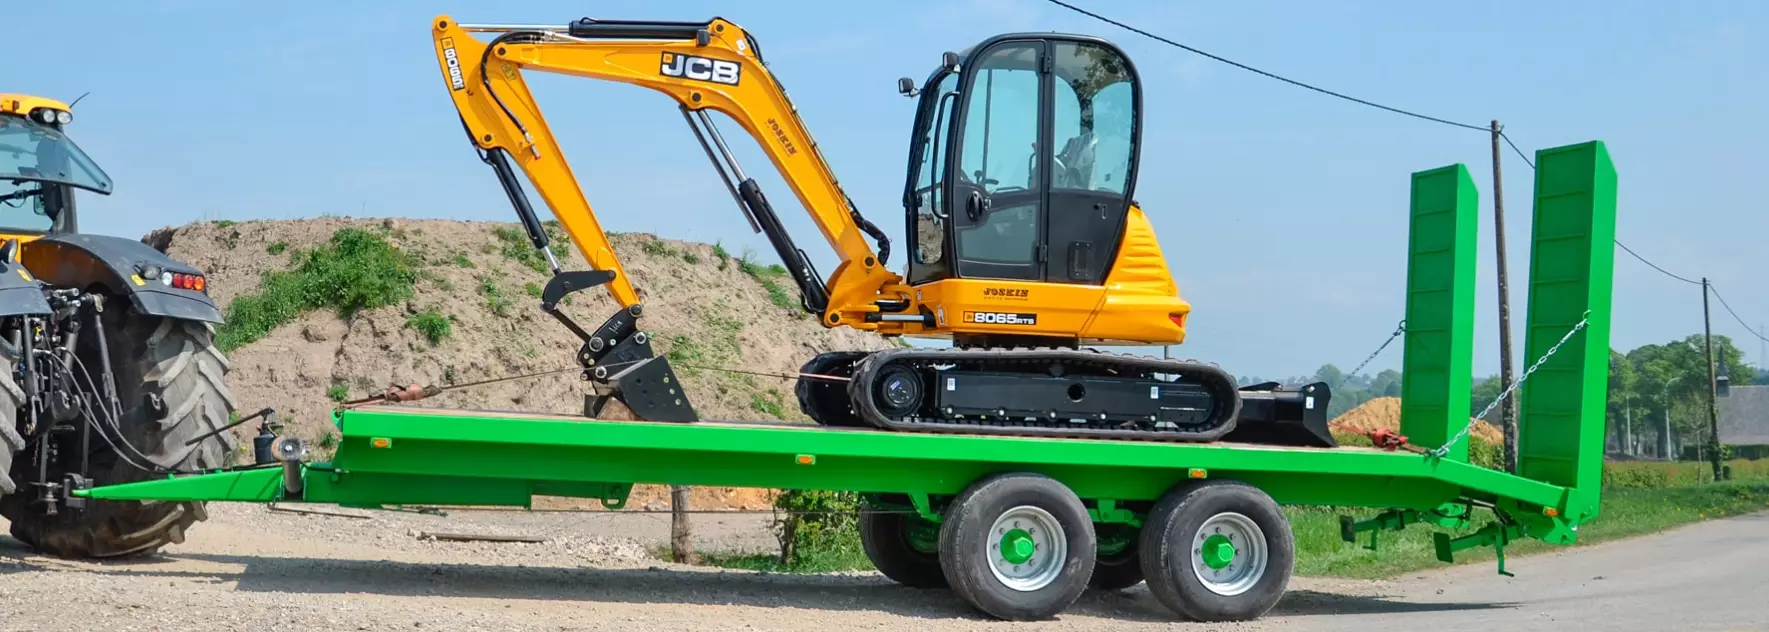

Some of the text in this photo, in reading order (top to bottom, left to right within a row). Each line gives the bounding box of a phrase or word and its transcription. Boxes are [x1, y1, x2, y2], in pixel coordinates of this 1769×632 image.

[661, 54, 739, 85] JCB
[767, 117, 798, 155] JOSKIN
[983, 287, 1029, 297] JOSKIN
